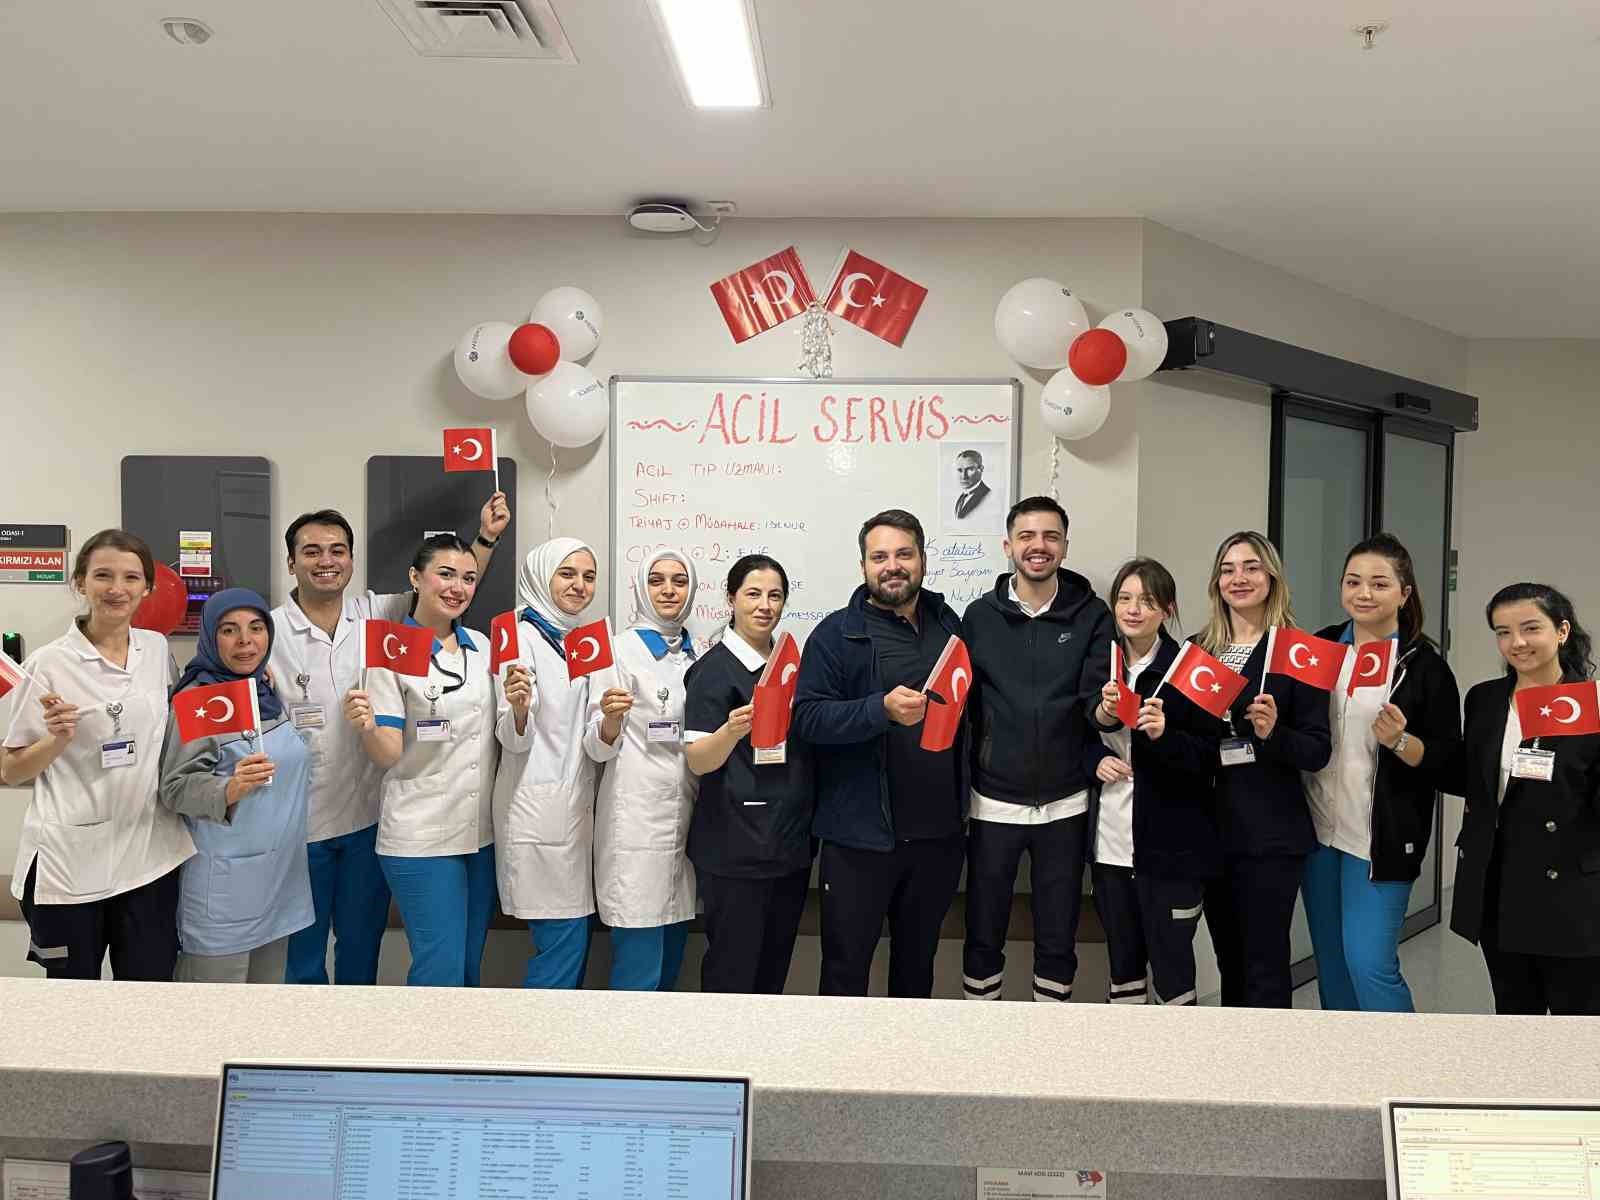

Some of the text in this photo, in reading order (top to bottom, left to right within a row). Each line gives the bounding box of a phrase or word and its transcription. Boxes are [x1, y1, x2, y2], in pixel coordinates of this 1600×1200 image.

[697, 392, 950, 444] ACİL SERVİS
[34, 556, 62, 566] ALAN
